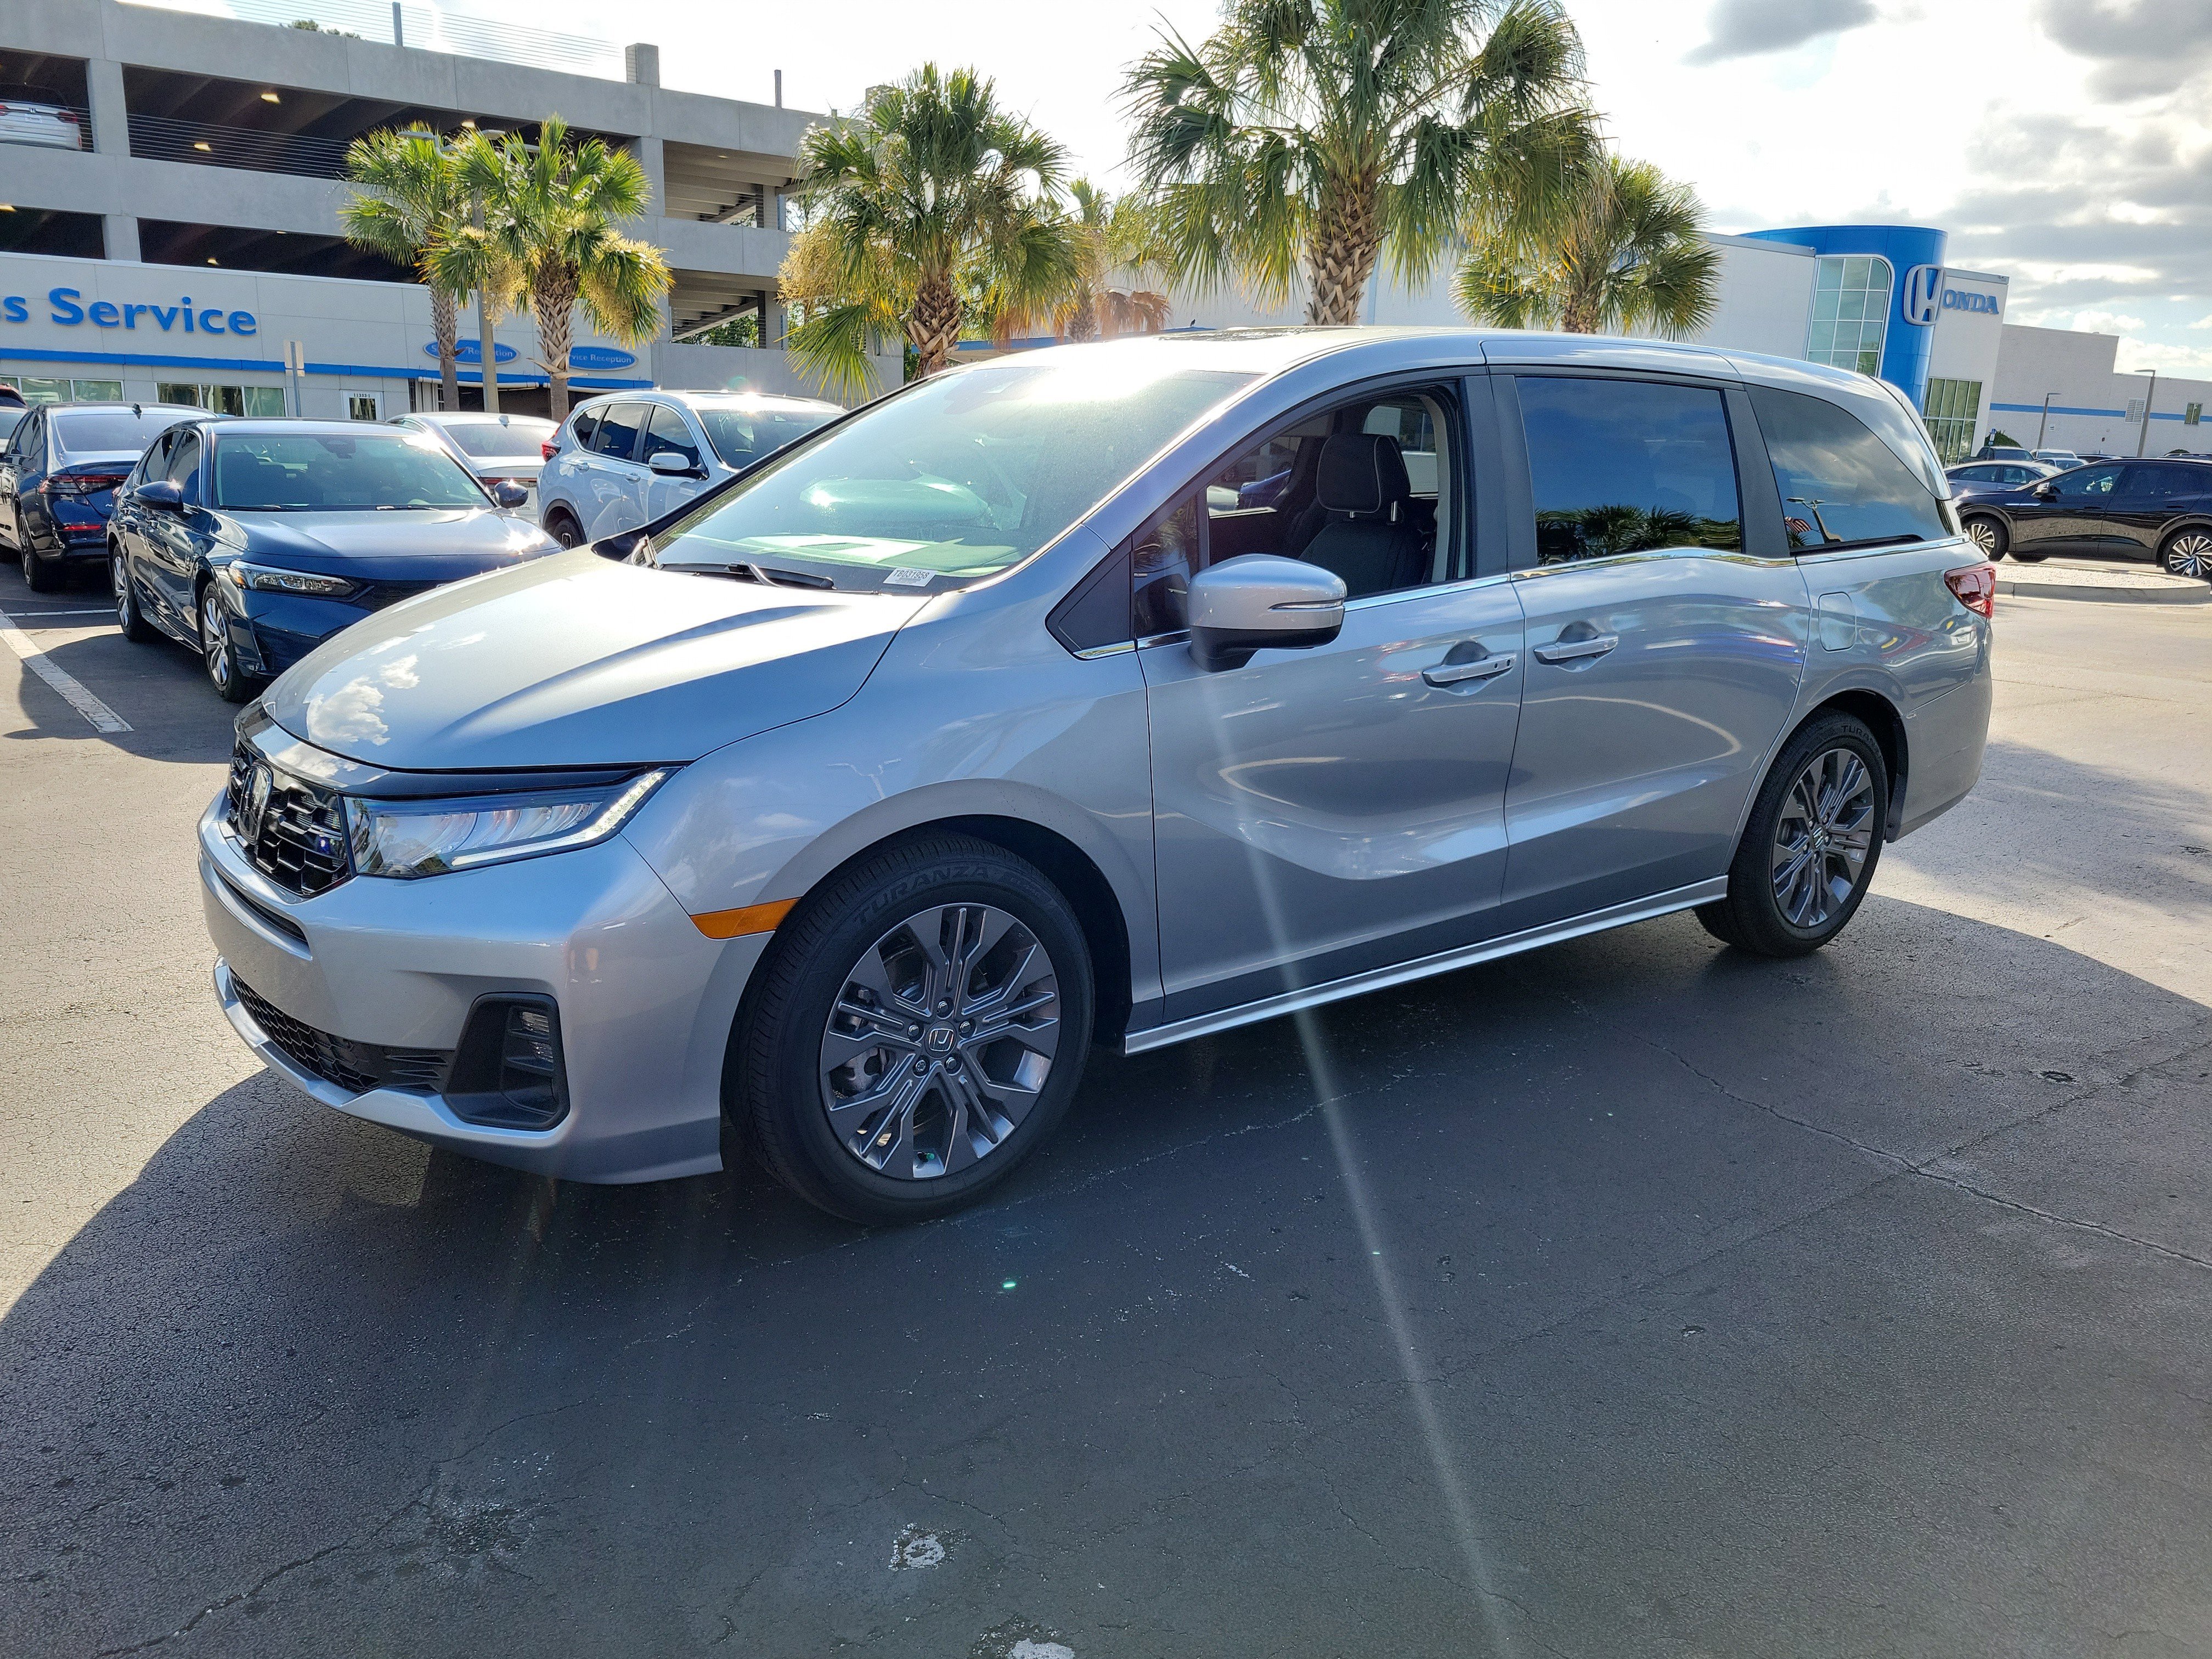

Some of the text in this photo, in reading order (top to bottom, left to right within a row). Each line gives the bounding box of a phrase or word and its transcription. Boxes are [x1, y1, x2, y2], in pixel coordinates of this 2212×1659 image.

[48, 287, 257, 336] Service
[1943, 289, 1999, 315] ONDA
[590, 354, 631, 363] Reception
[894, 569, 930, 579] TB031958
[854, 866, 989, 923] TURANZA
